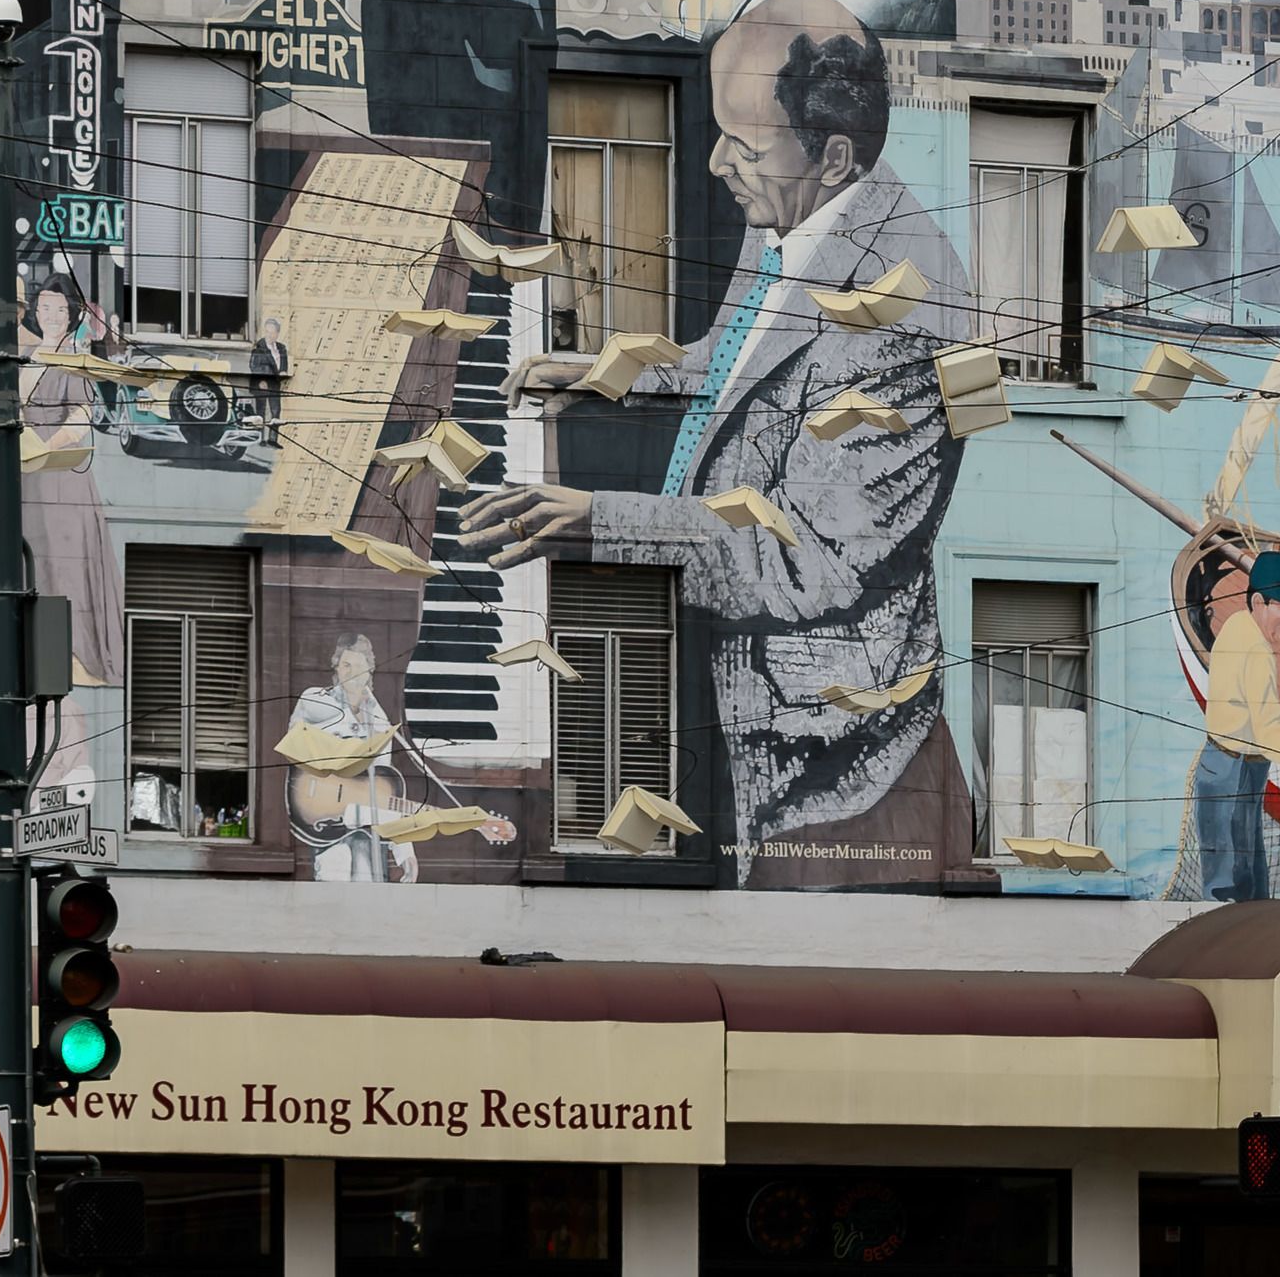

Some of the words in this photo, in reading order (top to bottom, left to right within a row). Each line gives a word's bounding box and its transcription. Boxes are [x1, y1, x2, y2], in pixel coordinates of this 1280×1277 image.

[210, 28, 365, 86] DOUGHERT
[74, 48, 94, 169] ROUGE
[24, 813, 80, 845] BROADWAY
[720, 841, 932, 861] www.BillWeberMuralist.com
[151, 1080, 228, 1122] Sun
[242, 1084, 352, 1135] Hong
[362, 1086, 469, 1138] Kong
[480, 1088, 693, 1131] Restaurant
